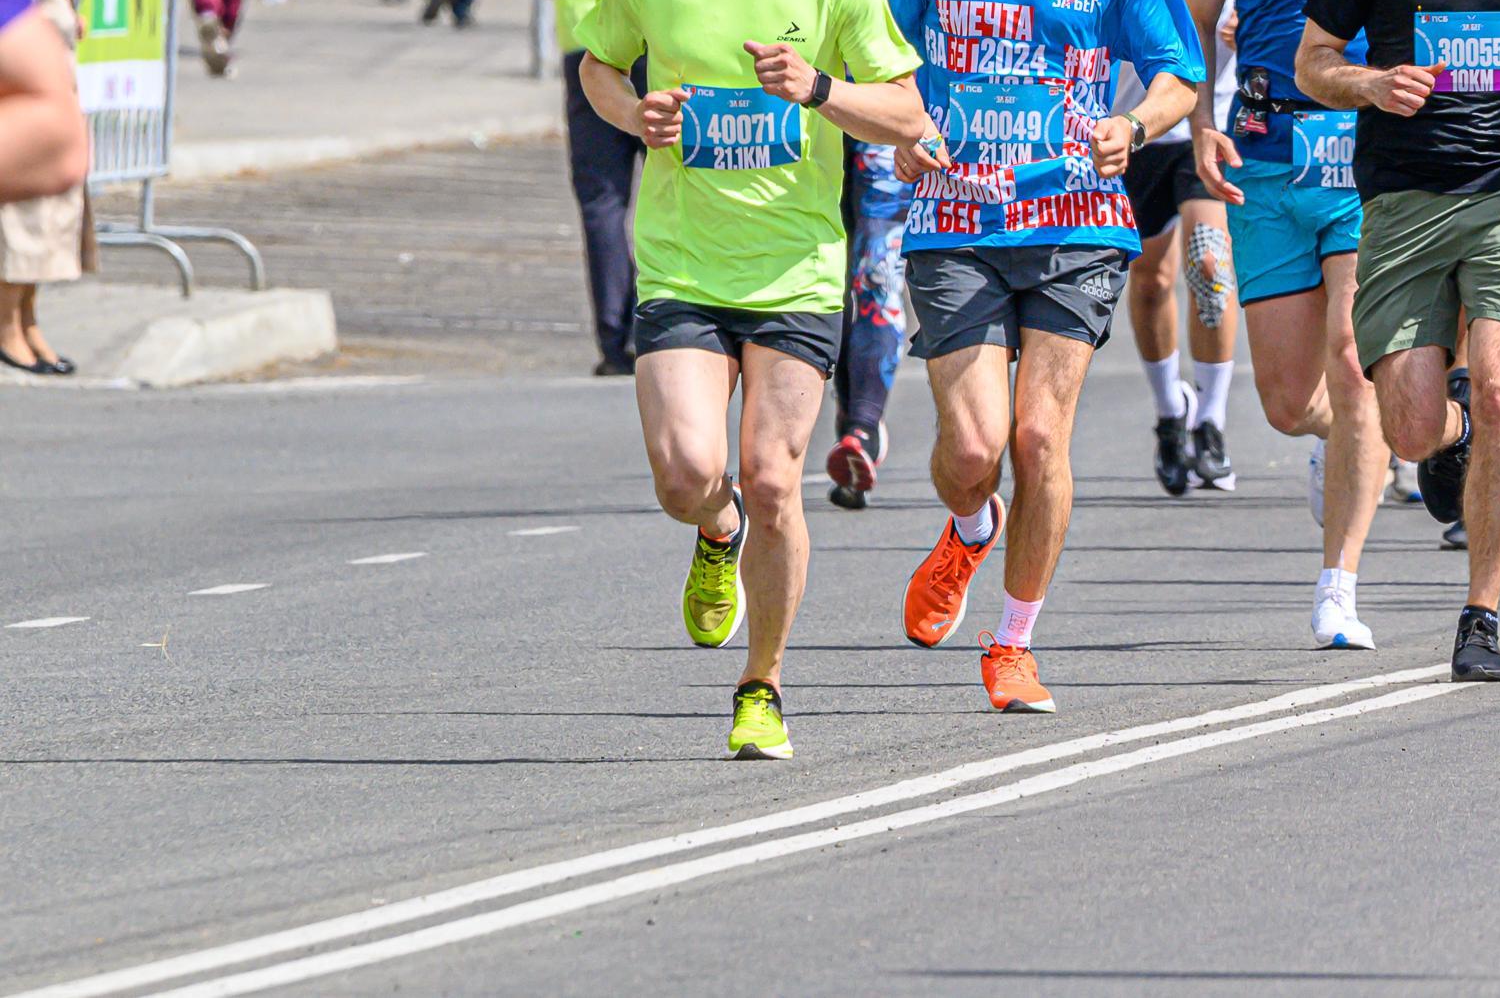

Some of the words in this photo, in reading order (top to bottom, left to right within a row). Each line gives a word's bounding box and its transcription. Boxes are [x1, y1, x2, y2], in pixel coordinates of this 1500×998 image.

[937, 0, 1034, 42] #МЕЧТА
[1450, 69, 1494, 92] 10KM
[707, 112, 775, 144] 40071
[970, 109, 1042, 141] 40049
[713, 145, 770, 170] 21.1KM
[978, 142, 1032, 165] 21.1KM
[1080, 283, 1114, 300] adidas
